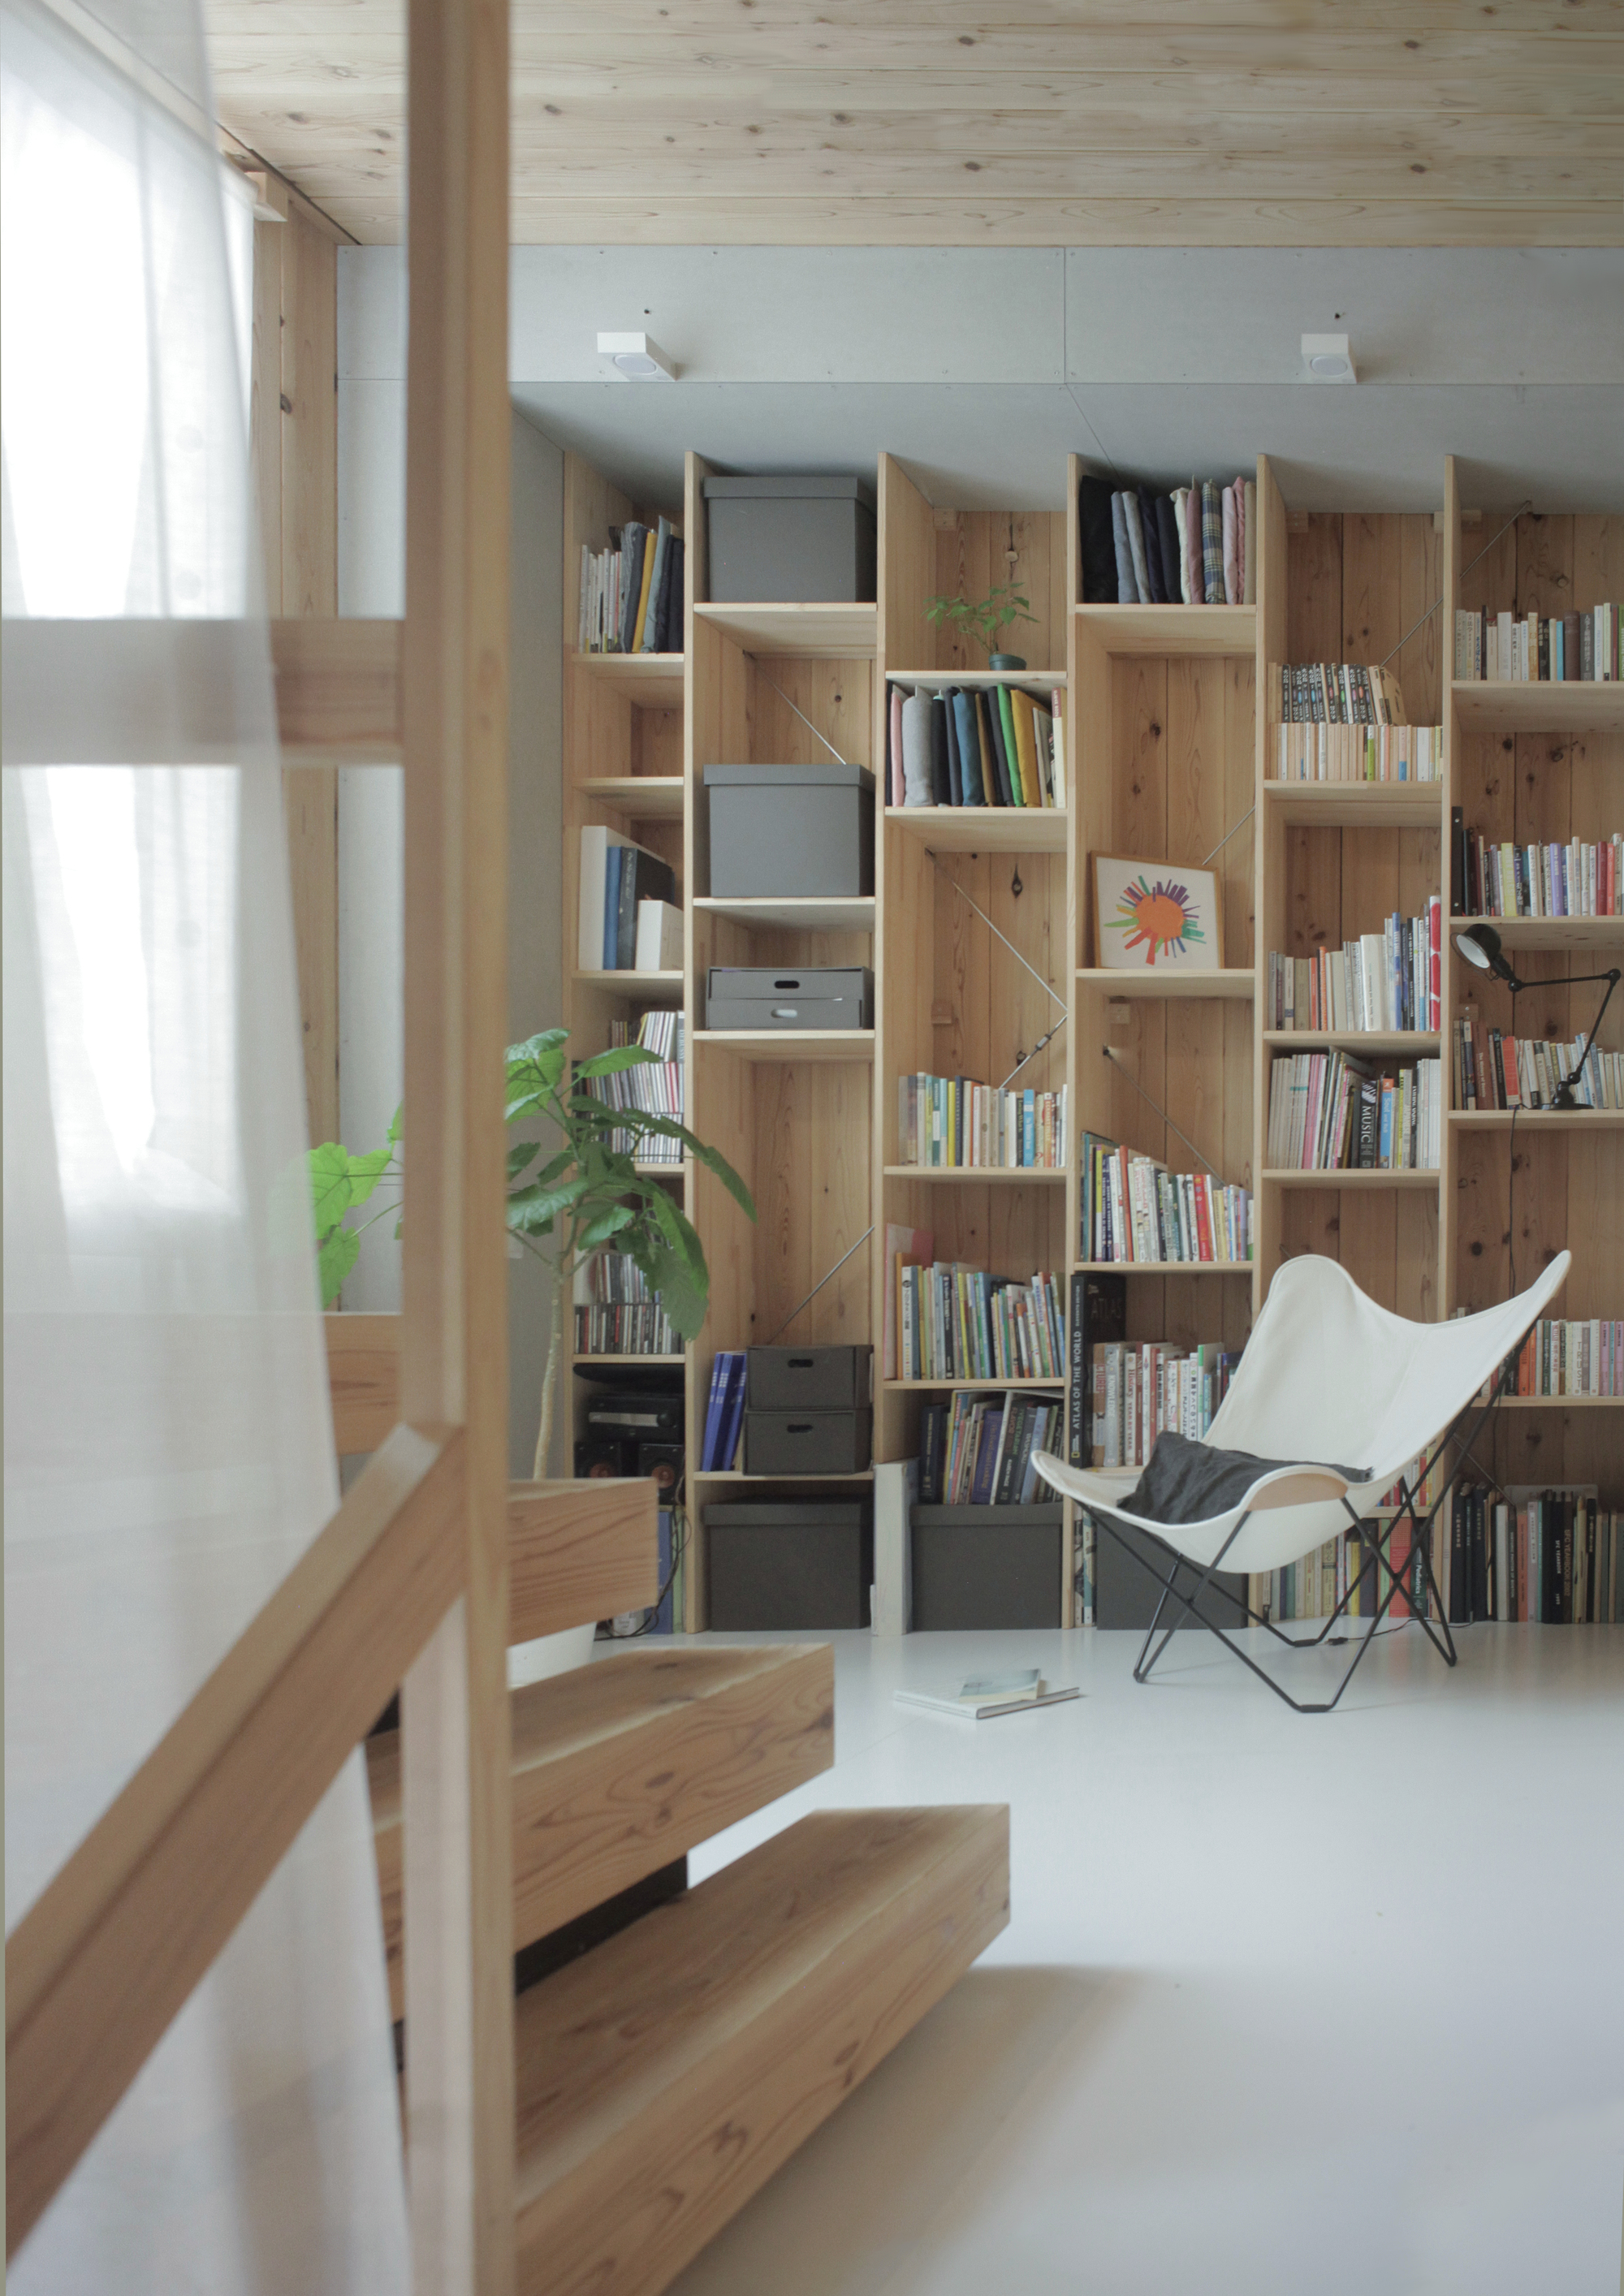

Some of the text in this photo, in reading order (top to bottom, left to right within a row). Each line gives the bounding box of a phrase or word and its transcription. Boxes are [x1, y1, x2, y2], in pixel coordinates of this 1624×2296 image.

[1361, 1106, 1371, 1143] MUSIC
[1073, 1331, 1082, 1363] WORLD
[1073, 1387, 1081, 1398] OF
[1108, 1375, 1116, 1418] KNOWLEDGE
[1127, 1369, 1135, 1398] History
[1009, 1407, 1018, 1434] FLAVOR
[1012, 1411, 1023, 1455] VEGETARIAN
[1021, 1433, 1031, 1464] WASHOKU
[983, 1464, 992, 1489] Cooking
